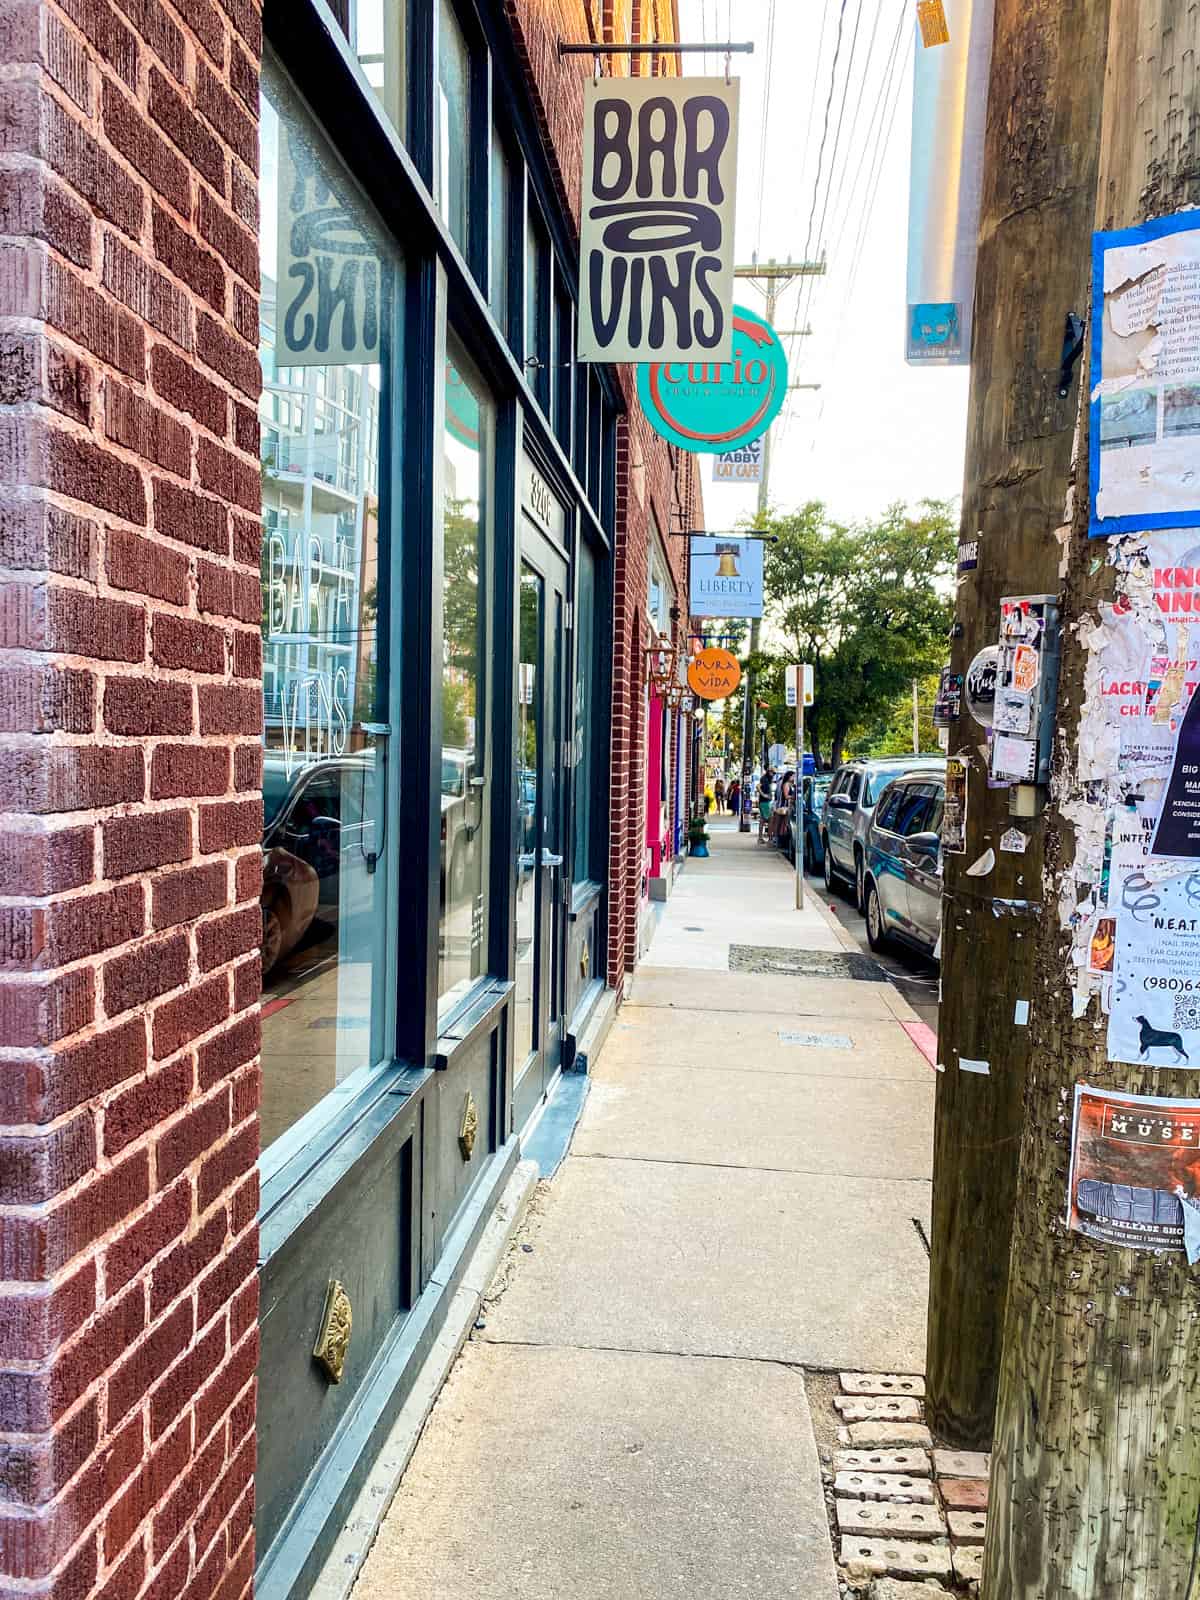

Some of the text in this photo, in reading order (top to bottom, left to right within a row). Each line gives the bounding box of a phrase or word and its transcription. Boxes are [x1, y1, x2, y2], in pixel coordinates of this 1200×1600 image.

[592, 95, 730, 204] BAR
[588, 250, 725, 350] VINS
[663, 348, 768, 384] curio
[700, 578, 754, 593] LIBERTY
[1154, 568, 1200, 588] KN
[696, 660, 735, 671] PURA
[698, 677, 730, 687] VIDA
[1111, 1120, 1193, 1140] MUSE
